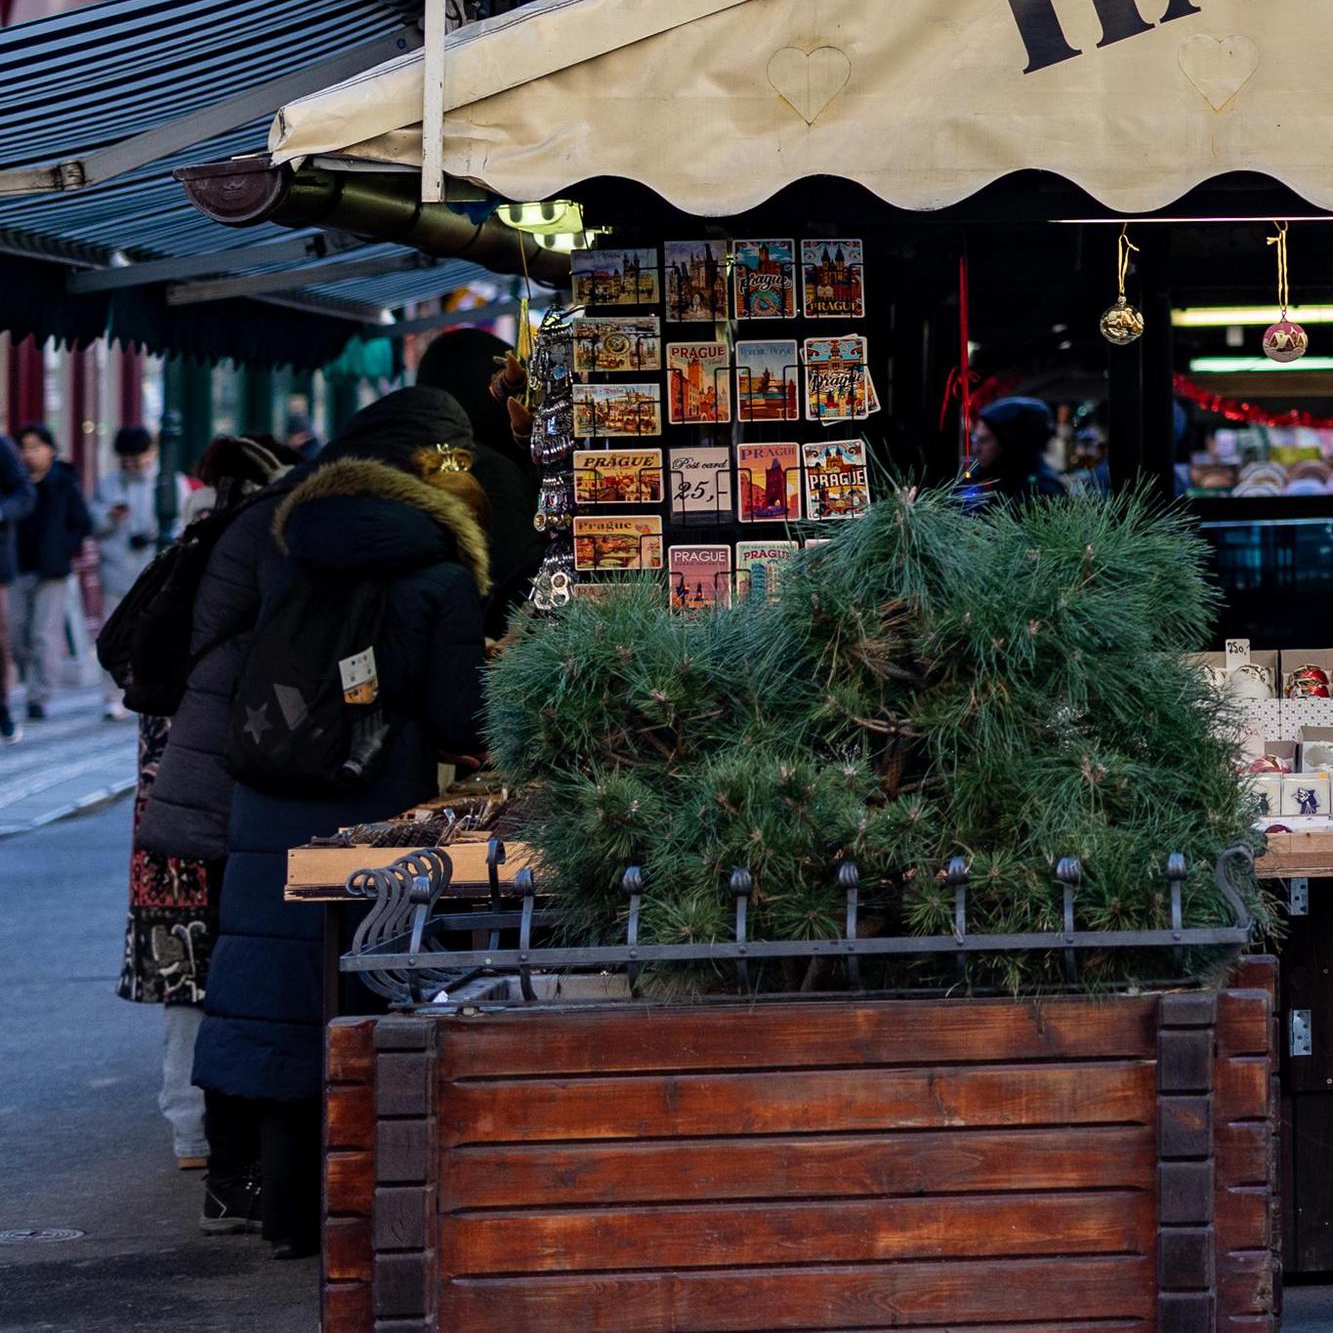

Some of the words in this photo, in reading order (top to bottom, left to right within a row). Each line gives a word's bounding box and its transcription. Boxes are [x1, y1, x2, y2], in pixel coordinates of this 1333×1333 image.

[671, 347, 726, 359] PRAGUE
[741, 447, 796, 461] PRAGUE
[583, 455, 654, 468] PRAGUE
[671, 456, 701, 469] Post
[809, 469, 865, 490] PRAGUE
[674, 550, 727, 563] PRAGUE
